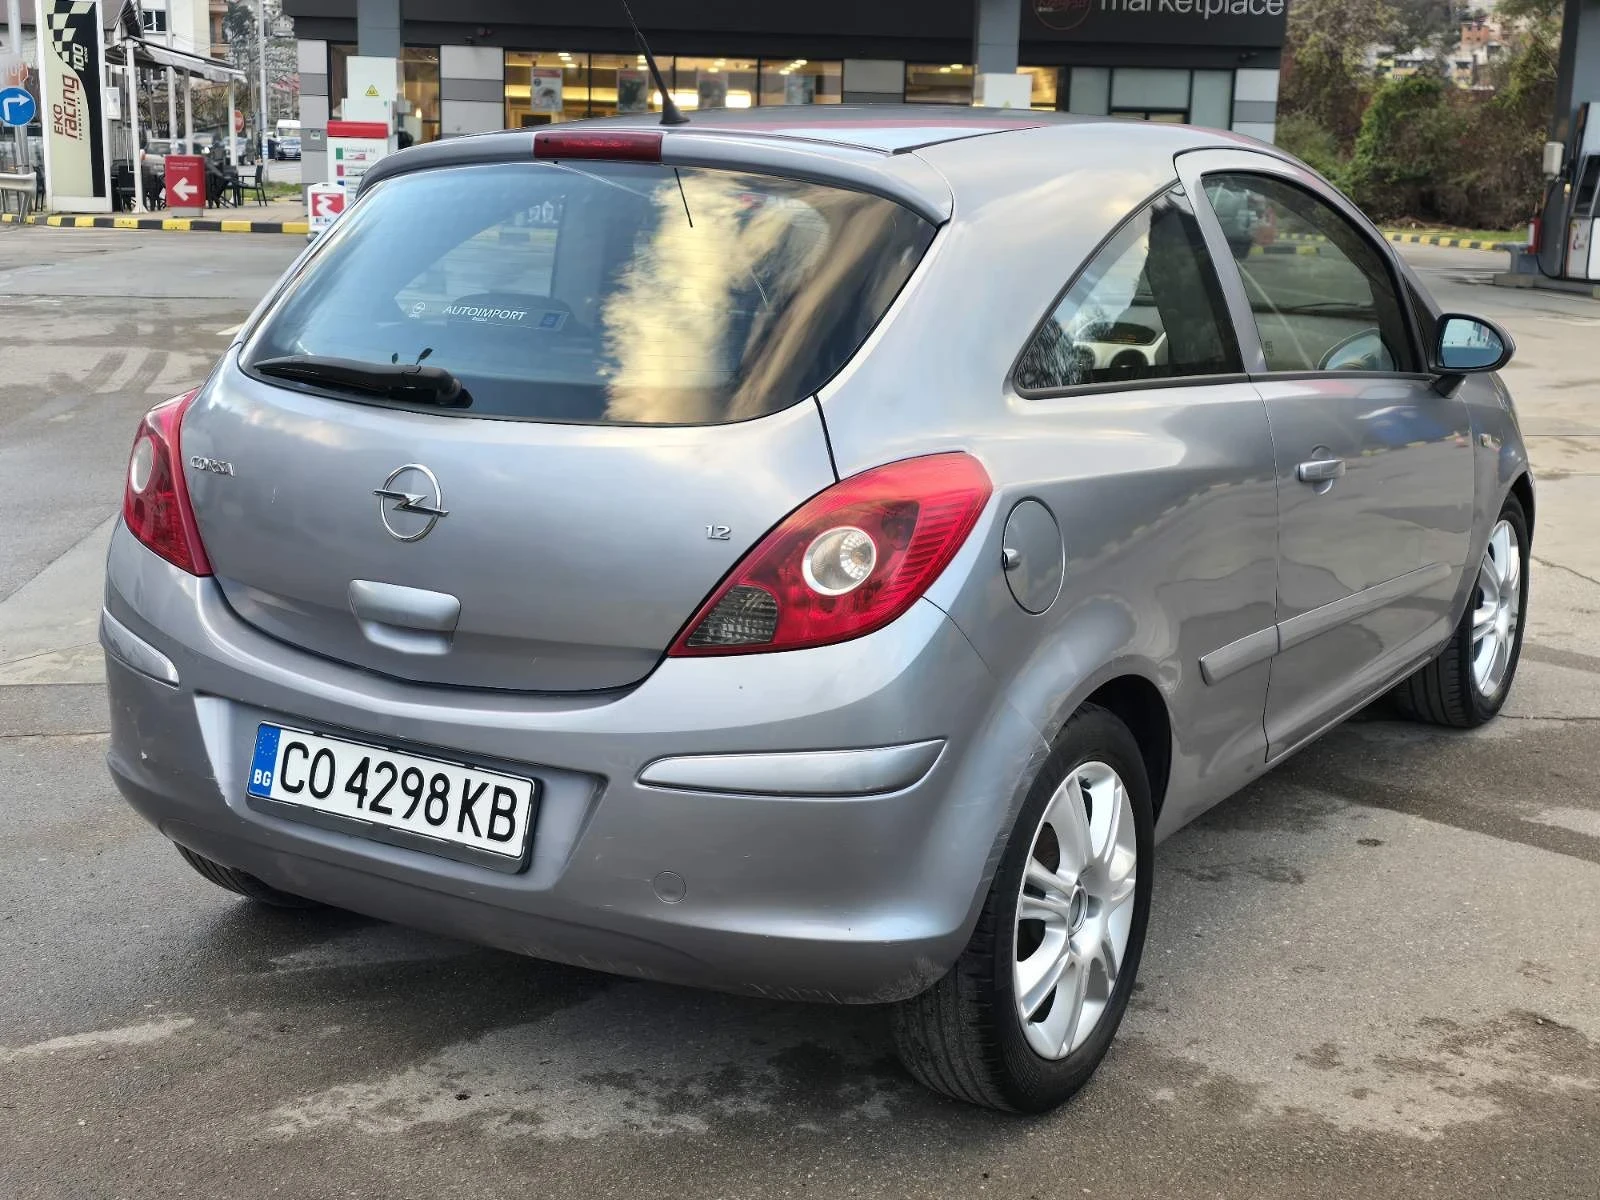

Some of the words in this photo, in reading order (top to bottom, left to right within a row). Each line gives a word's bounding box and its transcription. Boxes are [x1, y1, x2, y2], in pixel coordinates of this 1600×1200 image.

[72, 42, 84, 71] 100
[53, 103, 64, 135] EKO
[63, 74, 79, 139] racing
[443, 305, 528, 321] AUTOIMPORT
[253, 768, 272, 788] BG
[280, 741, 336, 800] CO
[344, 756, 451, 827] 4298
[457, 778, 517, 843] KB
